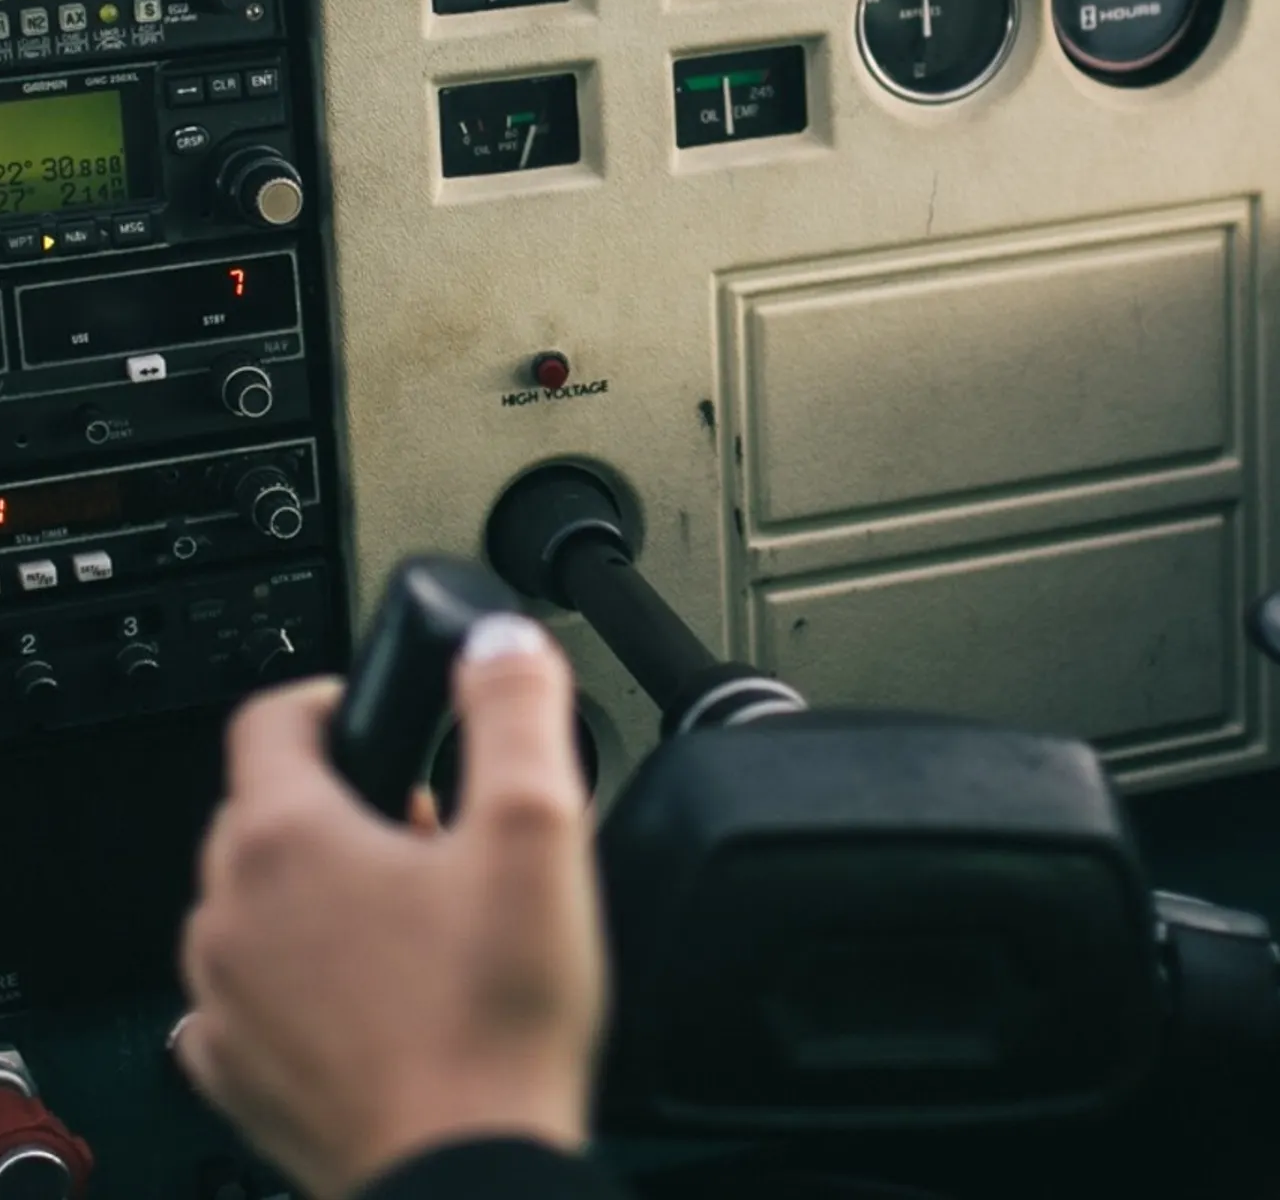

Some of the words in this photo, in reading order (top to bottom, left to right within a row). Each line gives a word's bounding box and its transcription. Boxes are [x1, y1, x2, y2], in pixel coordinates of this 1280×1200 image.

[144, 3, 155, 17] S
[1100, 2, 1162, 22] HOURS
[28, 16, 46, 29] N2
[66, 11, 84, 25] AX
[22, 79, 68, 93] GARMIN
[212, 78, 236, 92] CLR
[251, 73, 273, 88] ENT
[700, 108, 720, 124] OIL
[120, 221, 145, 235] MSG
[8, 234, 33, 249] WPT
[229, 268, 245, 296] 7
[71, 332, 90, 345] USE
[265, 340, 290, 353] NAV
[501, 389, 537, 407] HIGH
[544, 379, 609, 400] VOLTAGE
[123, 616, 139, 637] 3
[21, 634, 37, 655] 2
